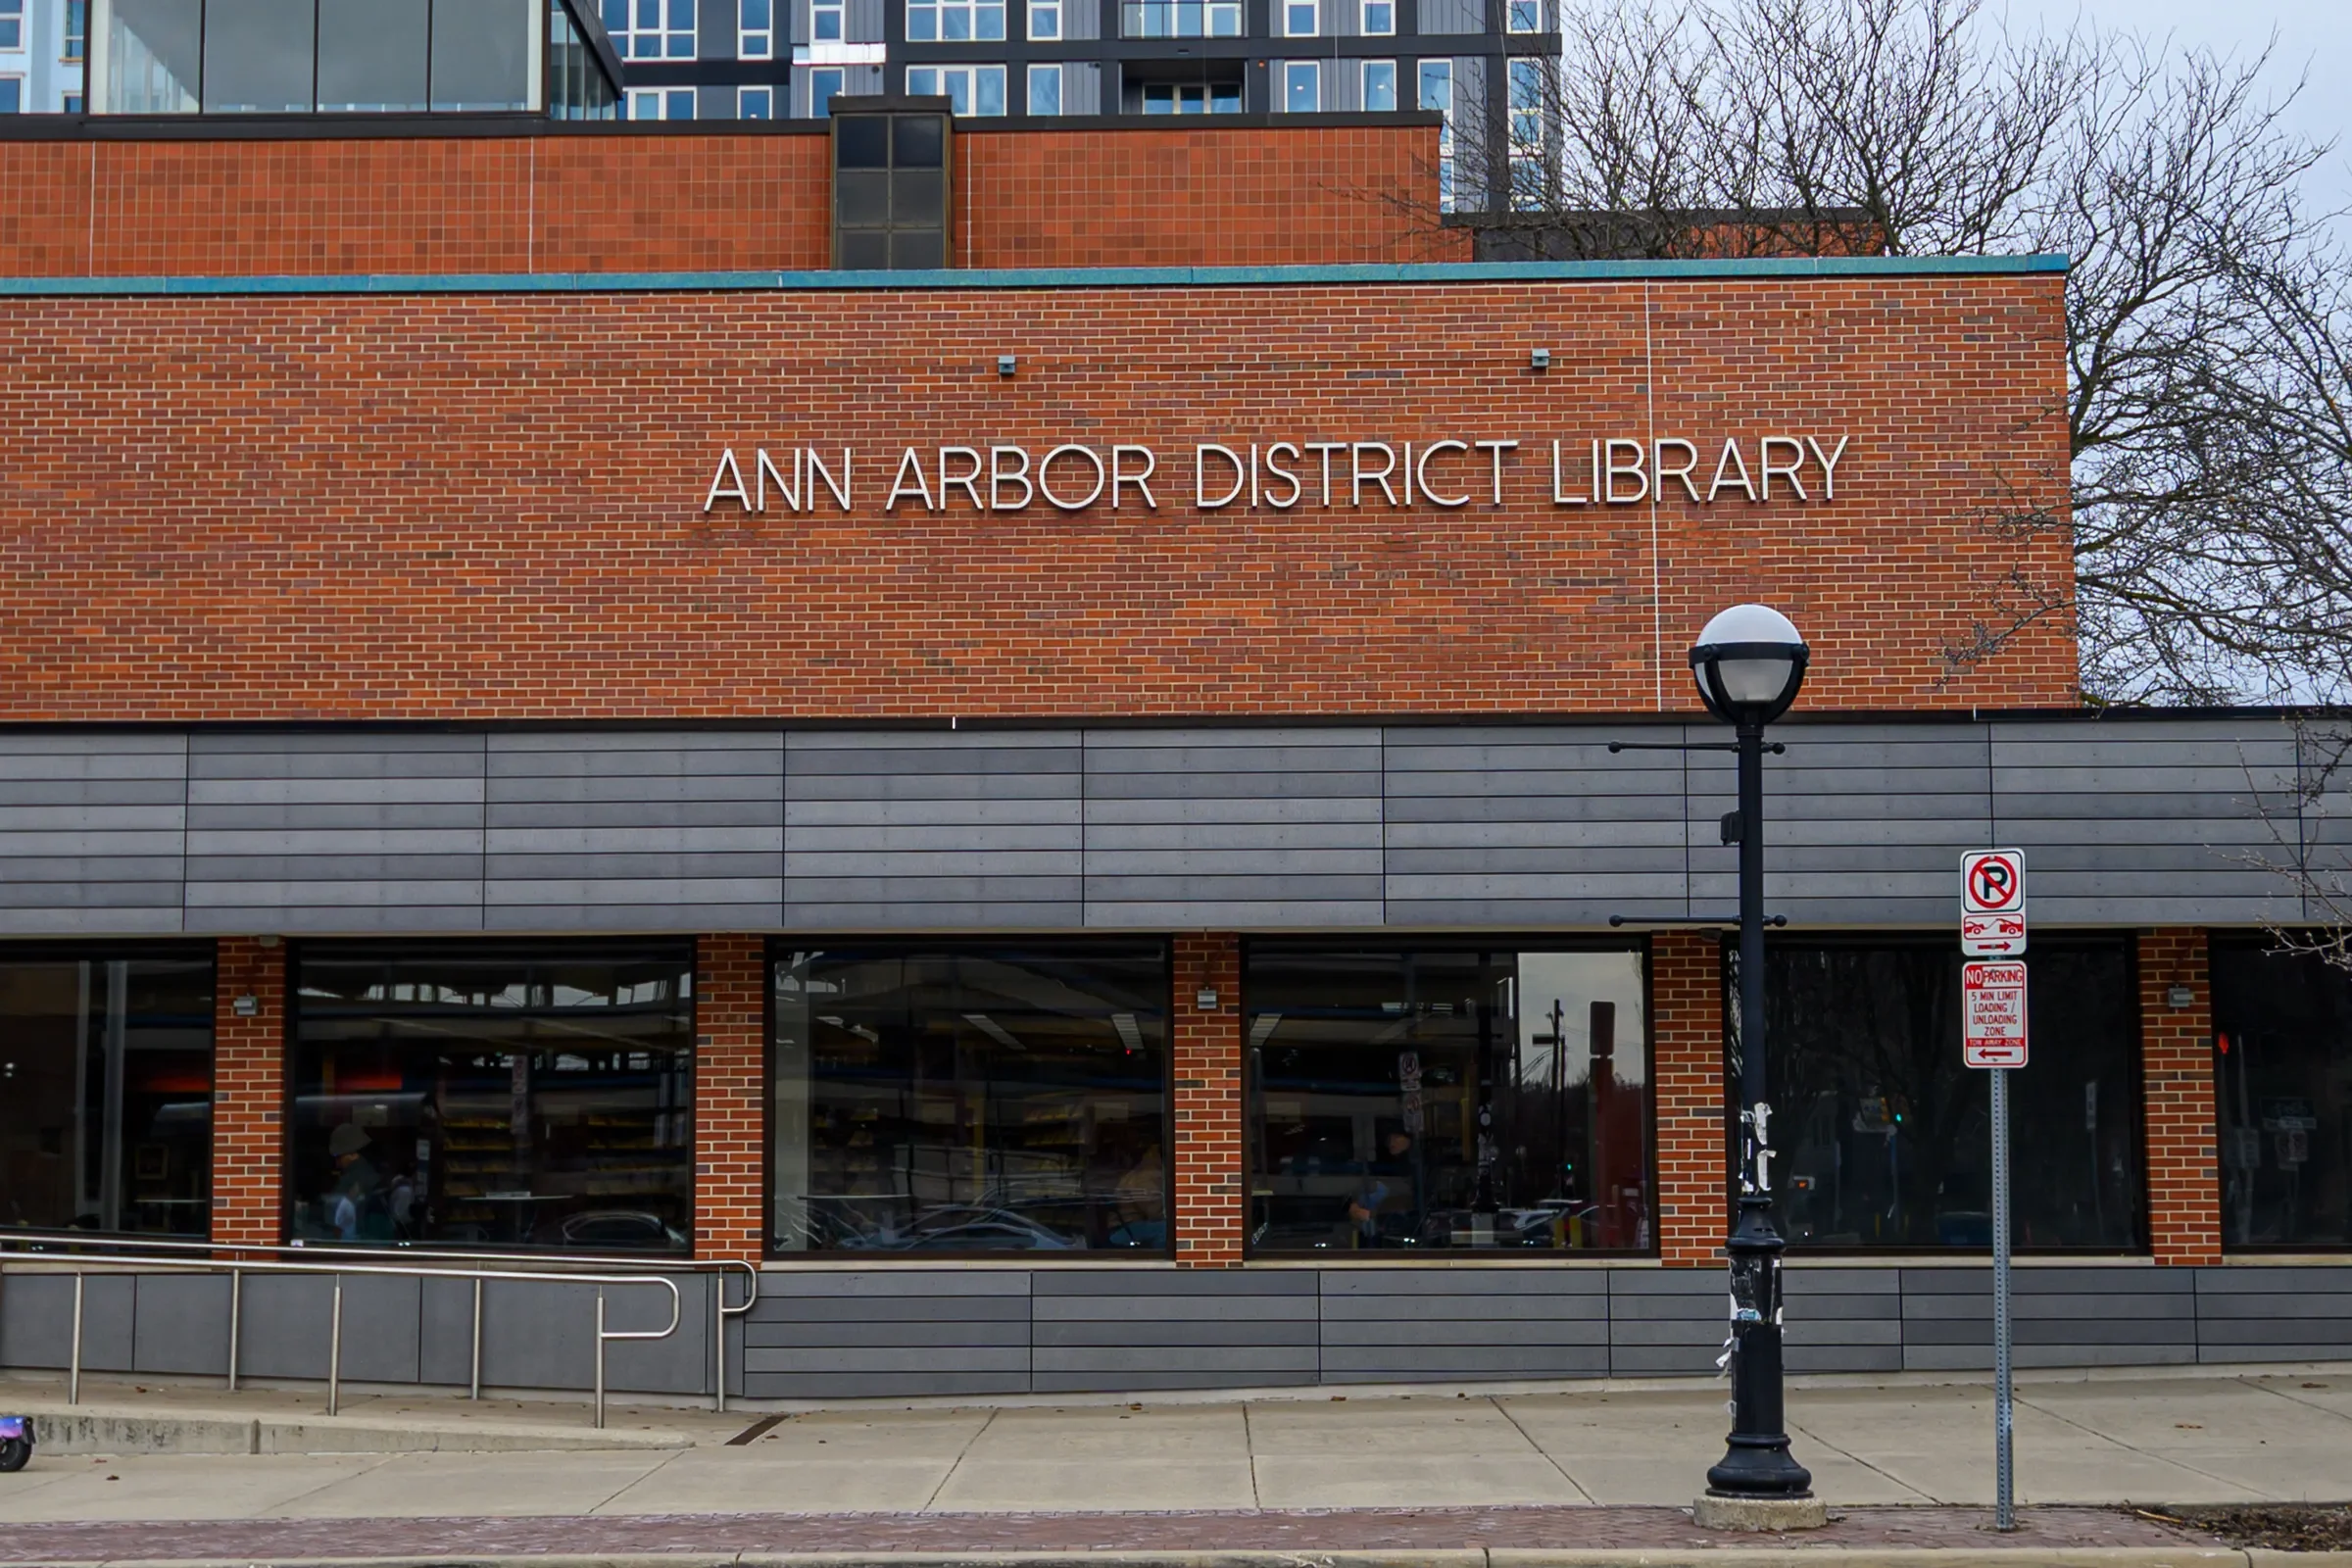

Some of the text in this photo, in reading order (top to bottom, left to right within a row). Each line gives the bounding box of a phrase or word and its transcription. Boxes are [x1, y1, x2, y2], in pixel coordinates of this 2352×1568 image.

[704, 435, 1849, 512] ANN ARBOR DISTRICT LIBRARY
[1984, 866, 2008, 899] P
[1966, 969, 2023, 985] NO PARKING
[1971, 991, 2018, 1002] 5 MIN LIMIT
[1974, 1003, 2008, 1013] LOADING
[1973, 1014, 2018, 1025] UNLOADING
[1984, 1026, 2006, 1037] ZONE
